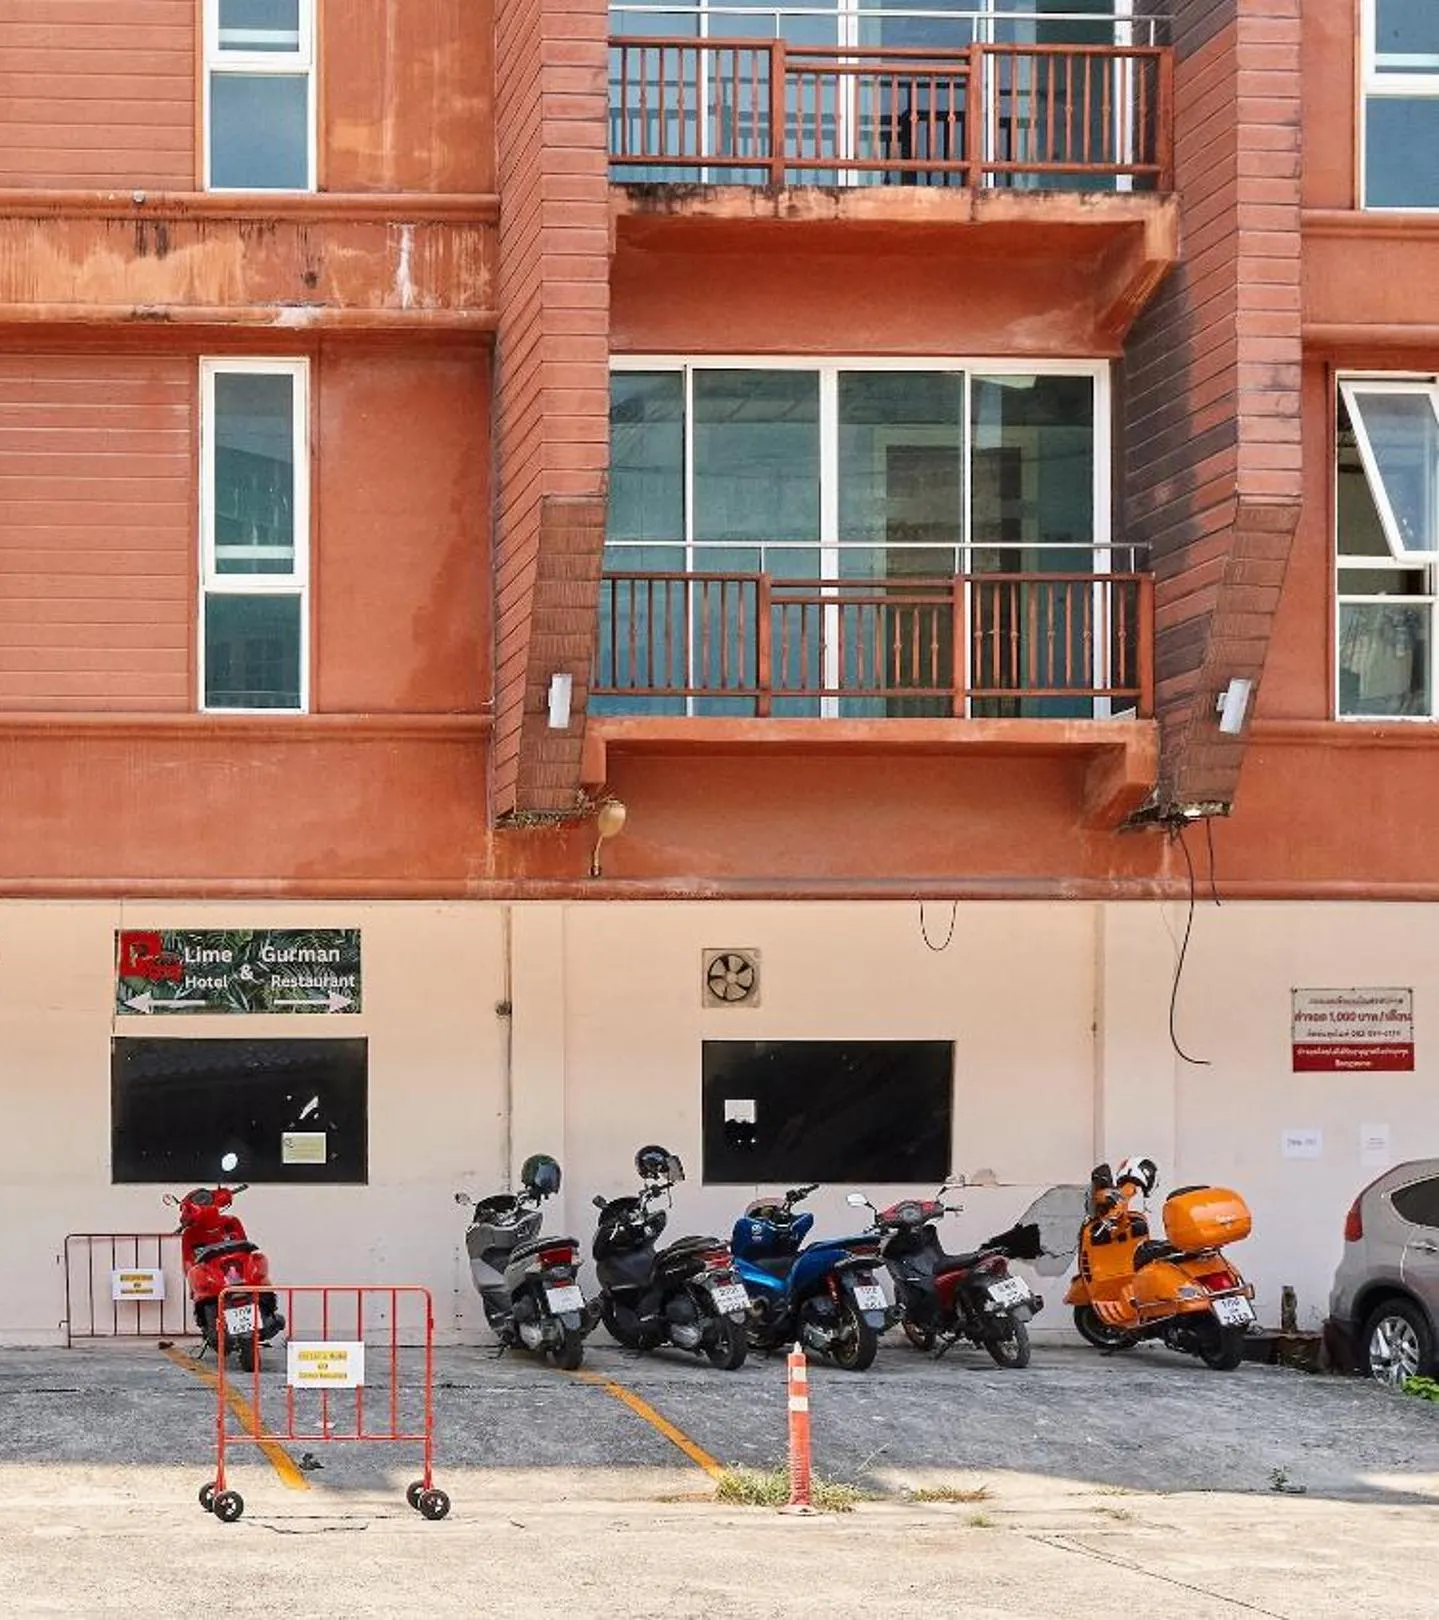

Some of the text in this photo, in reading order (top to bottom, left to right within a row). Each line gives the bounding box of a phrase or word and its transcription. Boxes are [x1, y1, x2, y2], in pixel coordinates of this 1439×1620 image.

[184, 945, 341, 963] Lime Gurman
[239, 964, 256, 981] &
[184, 974, 356, 989] Hotel Restaurant
